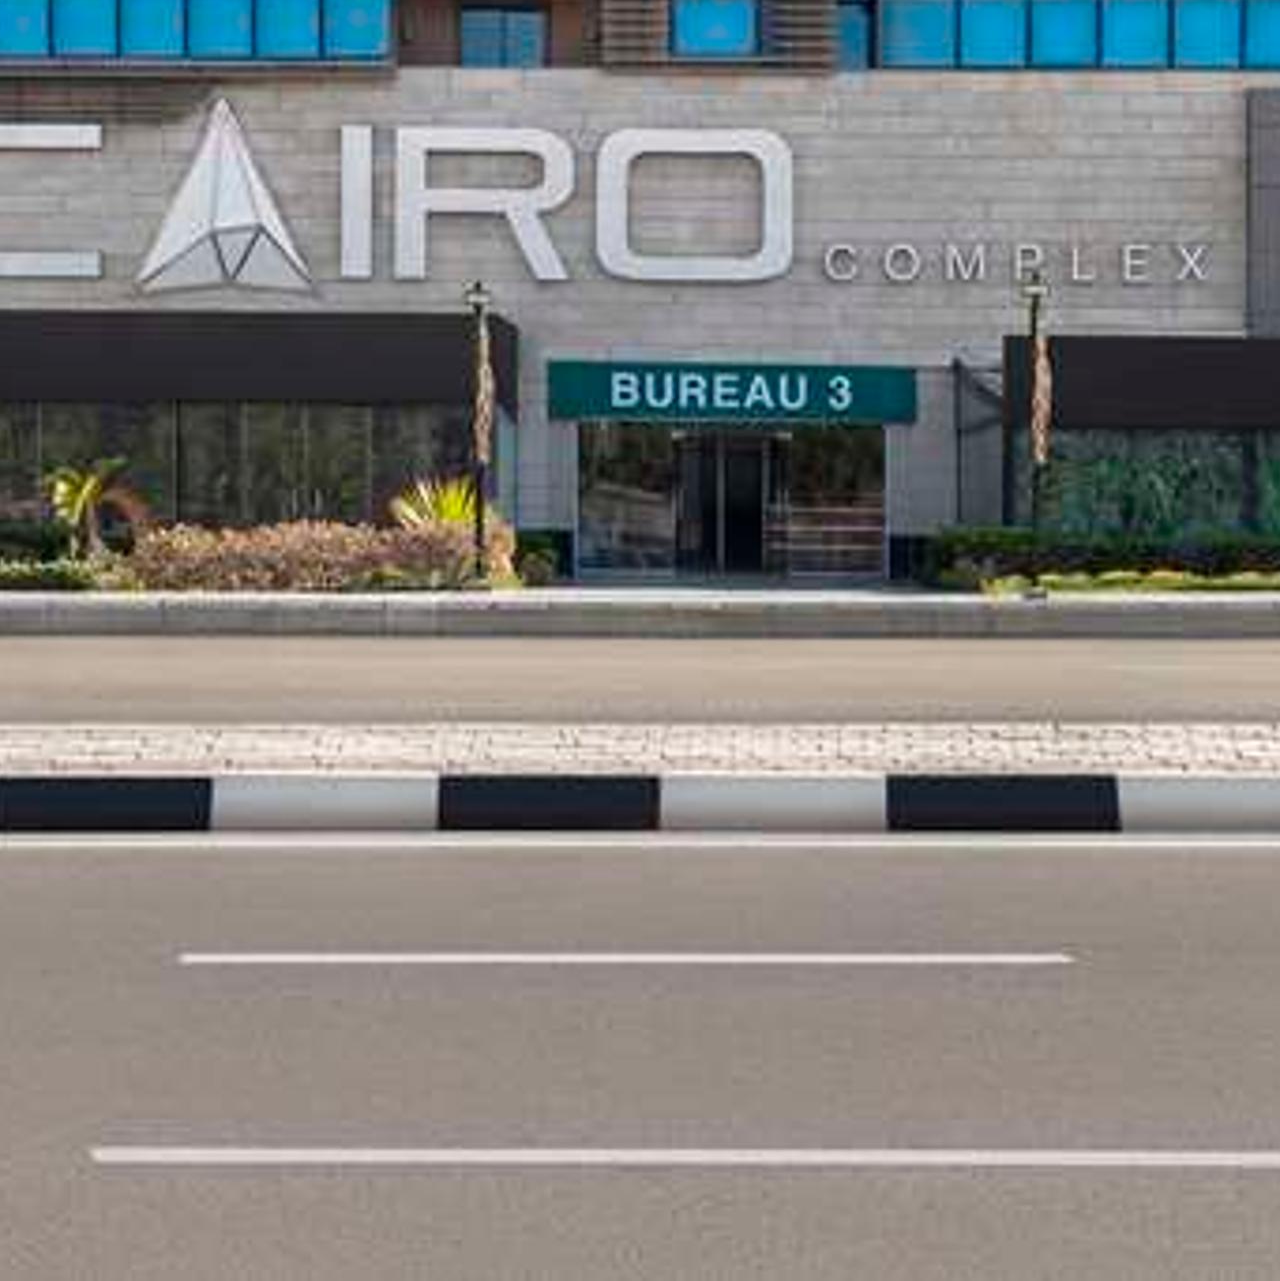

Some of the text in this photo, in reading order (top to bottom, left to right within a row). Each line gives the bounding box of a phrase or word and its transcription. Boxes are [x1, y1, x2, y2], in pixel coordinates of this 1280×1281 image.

[823, 243, 1210, 282] COMPLEX
[610, 371, 854, 412] BUREAU 3
